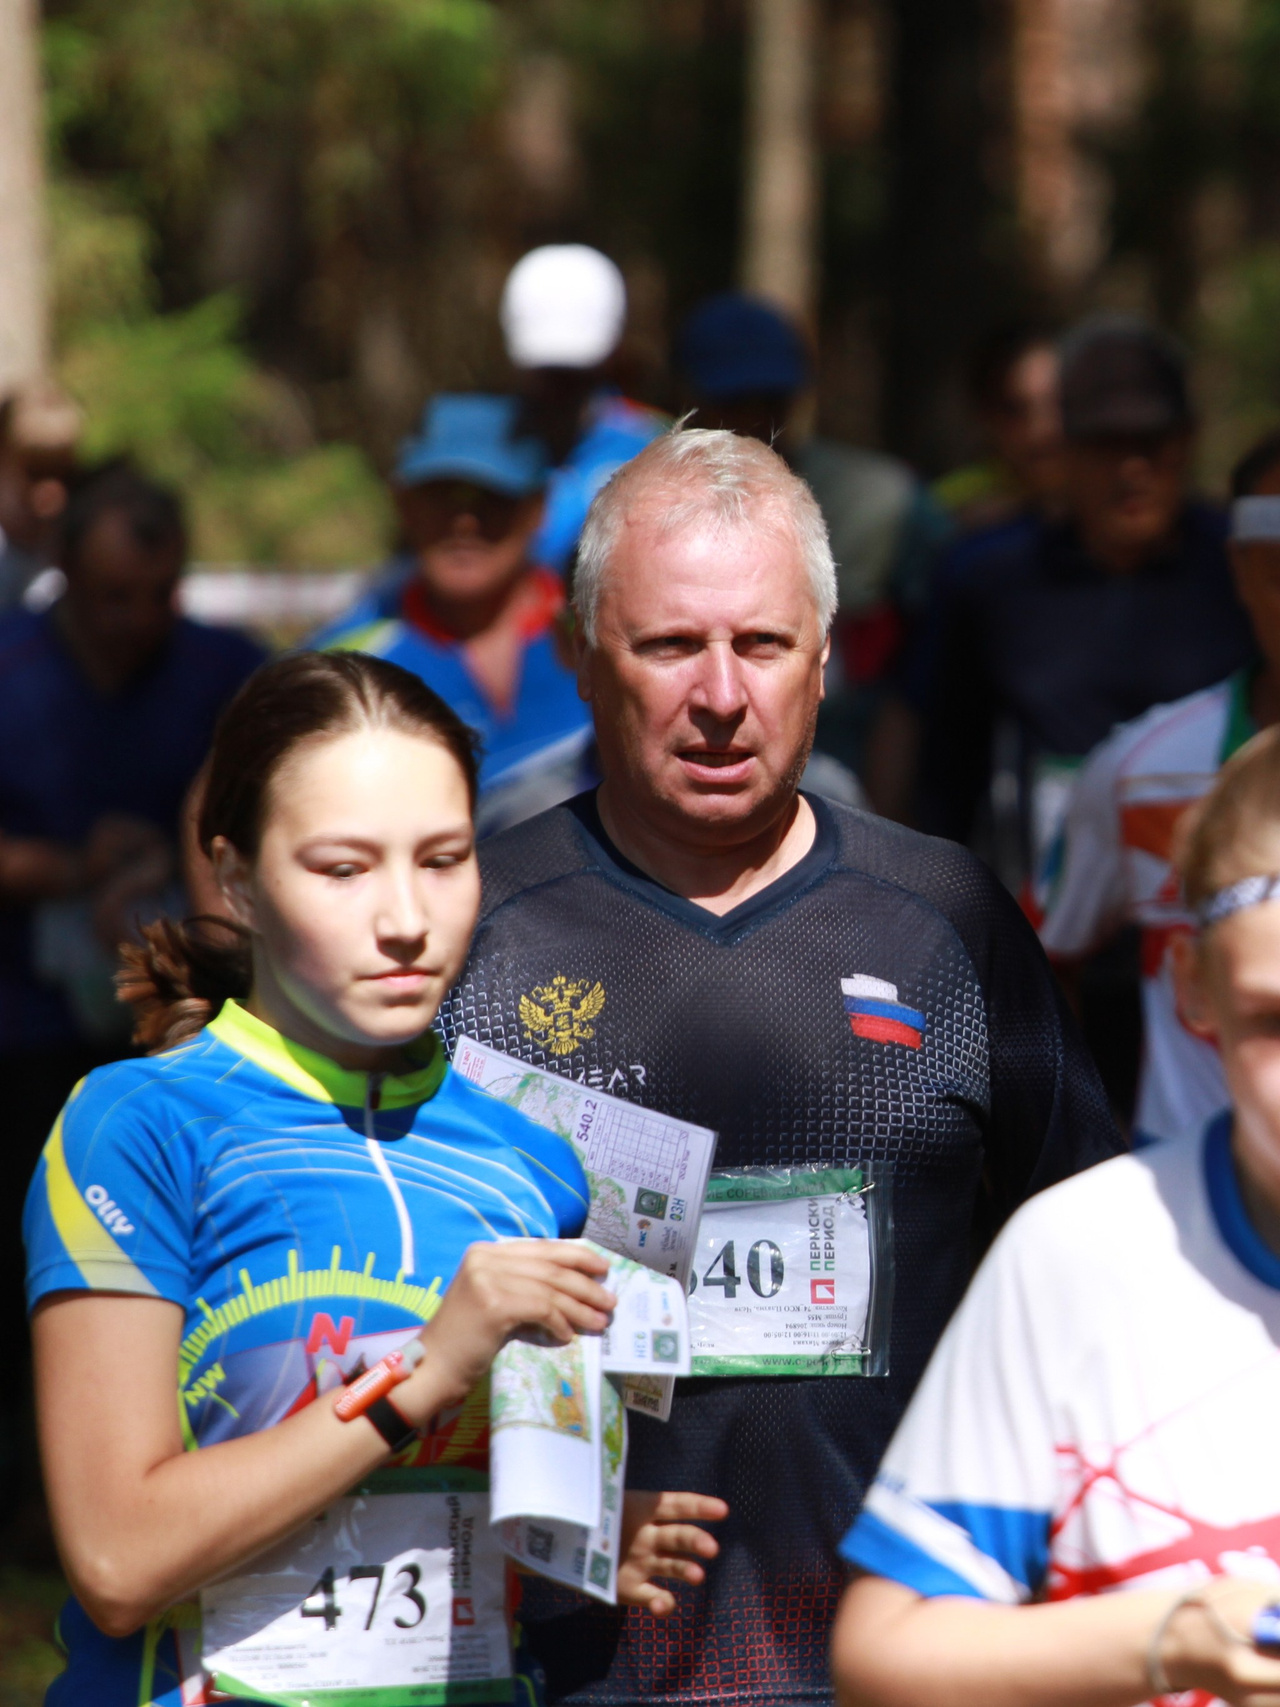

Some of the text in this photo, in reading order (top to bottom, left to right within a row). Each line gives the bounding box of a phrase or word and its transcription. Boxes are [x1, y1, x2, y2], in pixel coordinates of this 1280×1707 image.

[576, 1064, 647, 1091] EAR
[576, 1099, 598, 1142] 540.2
[807, 1197, 821, 1271] ПЕРМСКИ
[822, 1205, 836, 1271] ПЕРИОД
[687, 1239, 784, 1298] 40
[304, 1312, 355, 1355] N
[184, 1362, 226, 1406] NW
[300, 1562, 427, 1631] 473
